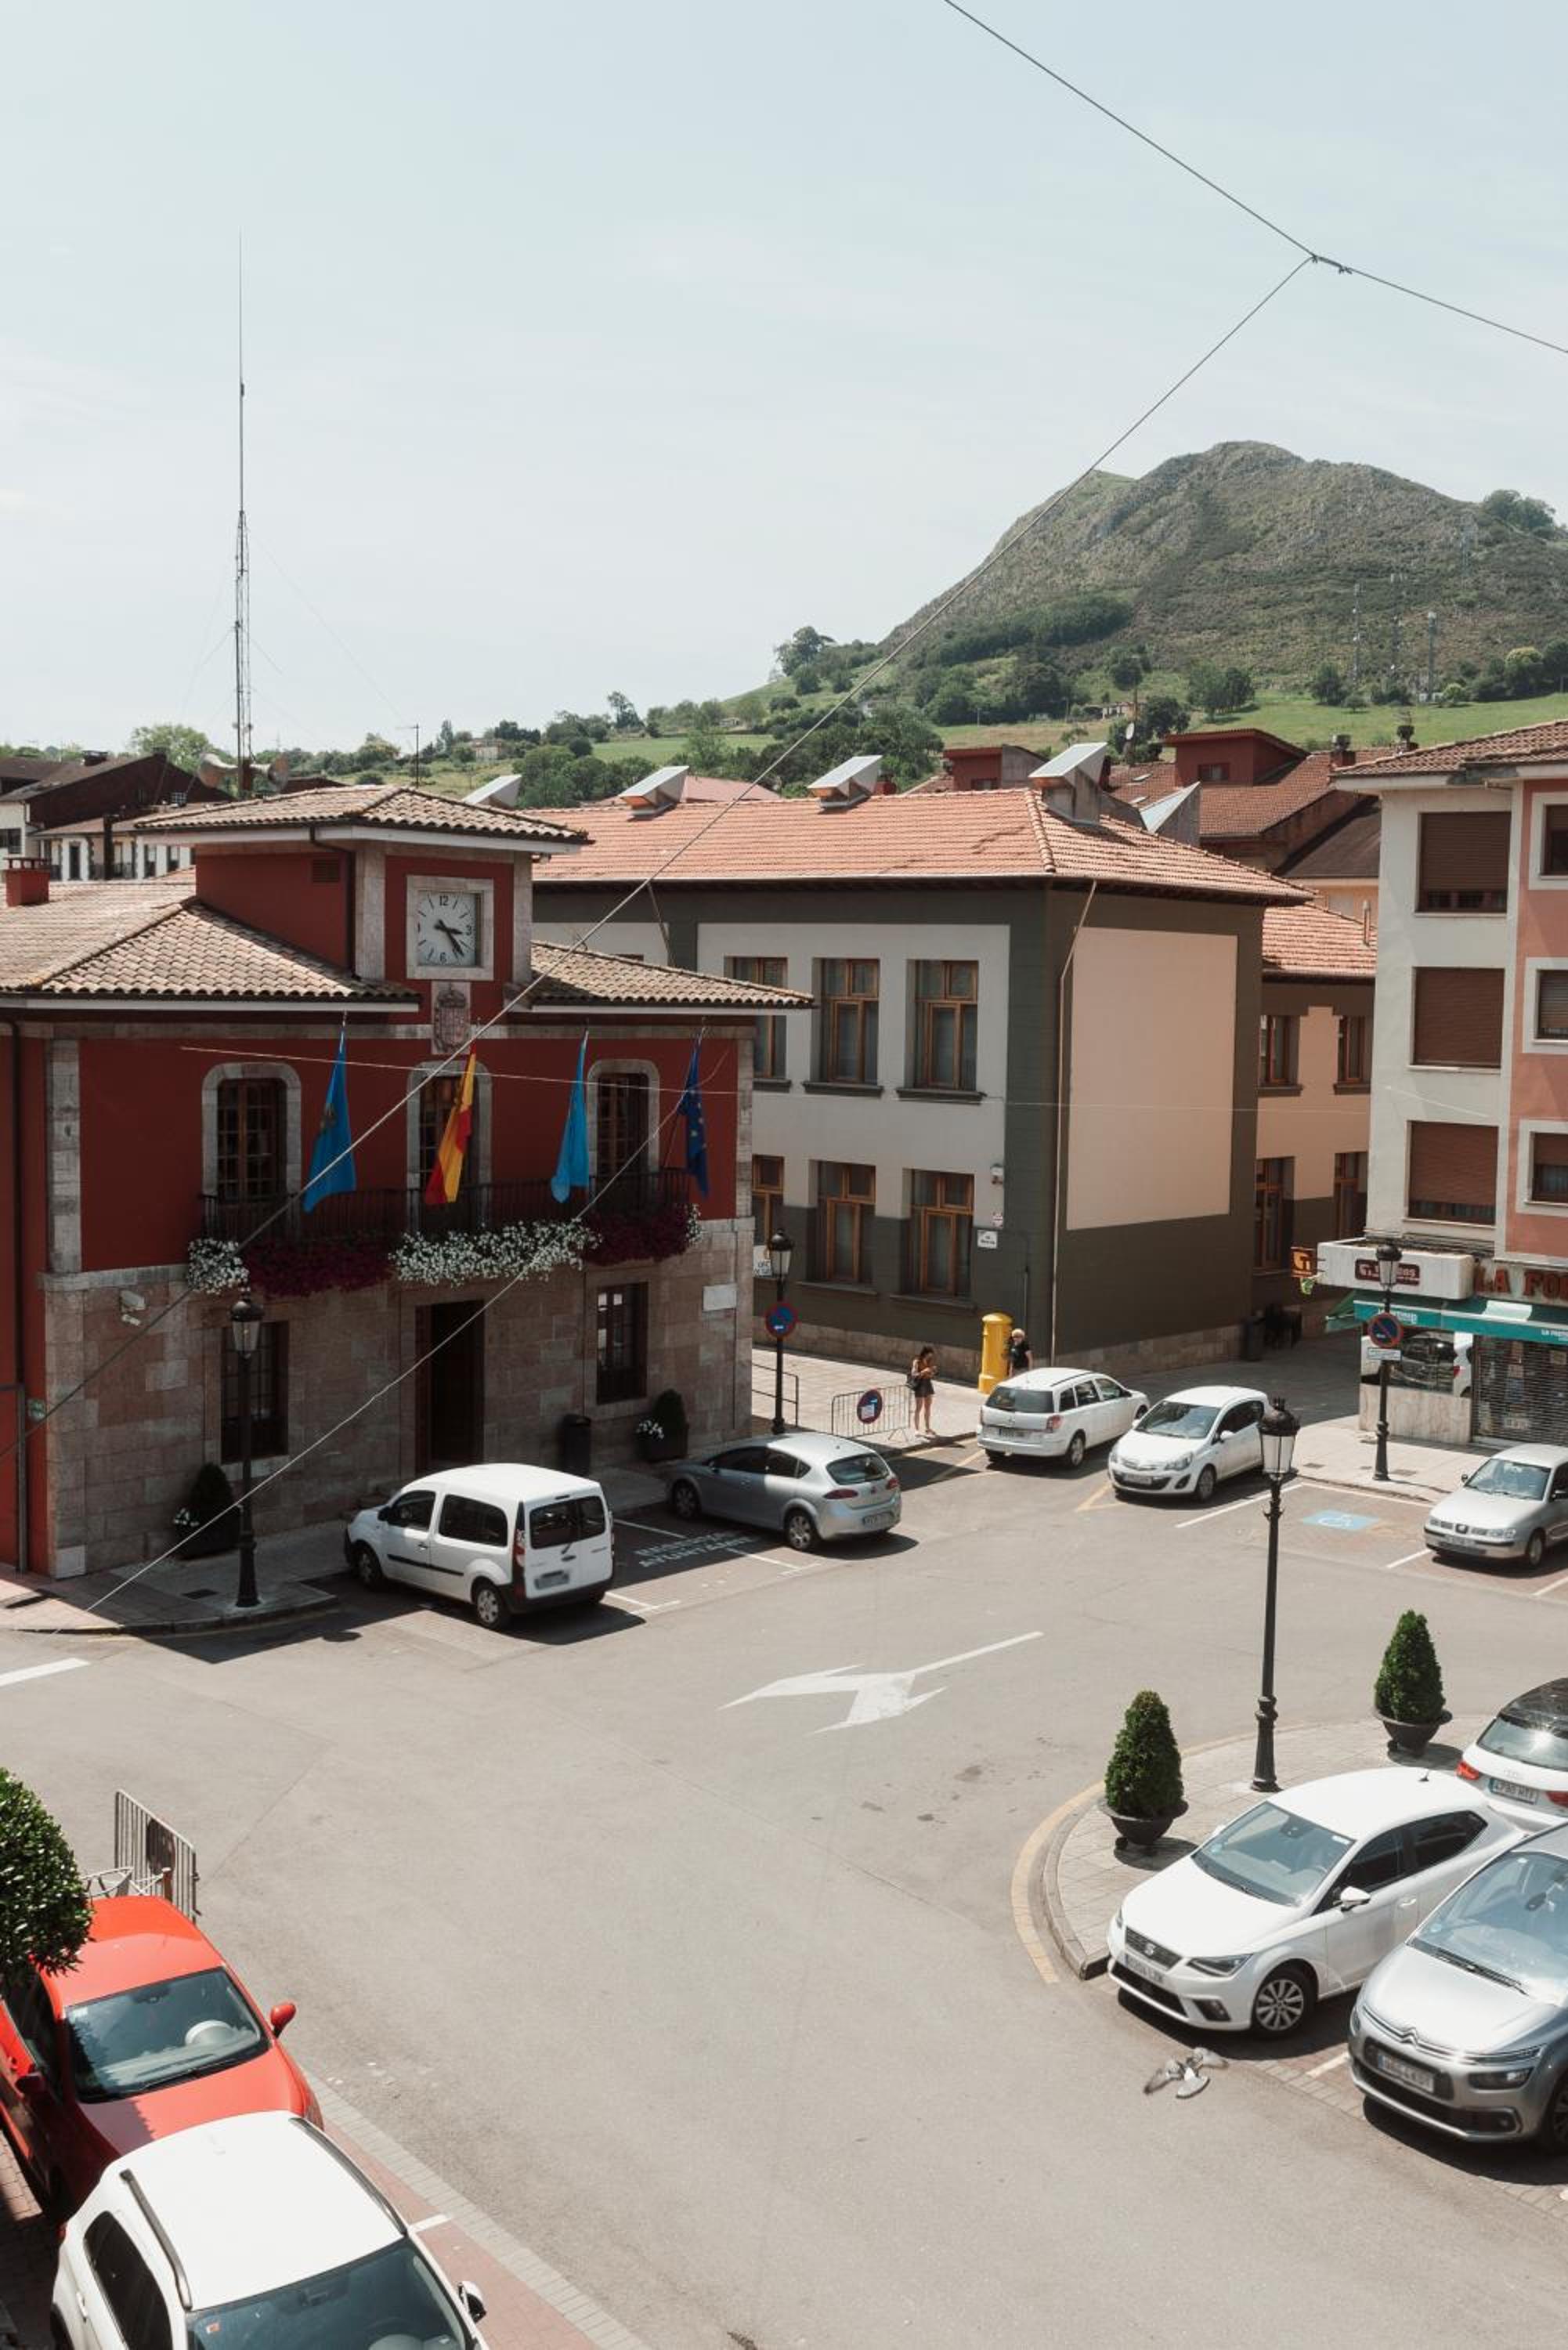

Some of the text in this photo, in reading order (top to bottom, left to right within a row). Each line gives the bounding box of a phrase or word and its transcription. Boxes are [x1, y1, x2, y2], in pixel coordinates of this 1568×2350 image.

[439, 895, 449, 906] 12
[466, 925, 472, 936] 3
[439, 952, 447, 964] 6
[1473, 1265, 1511, 1293] LA
